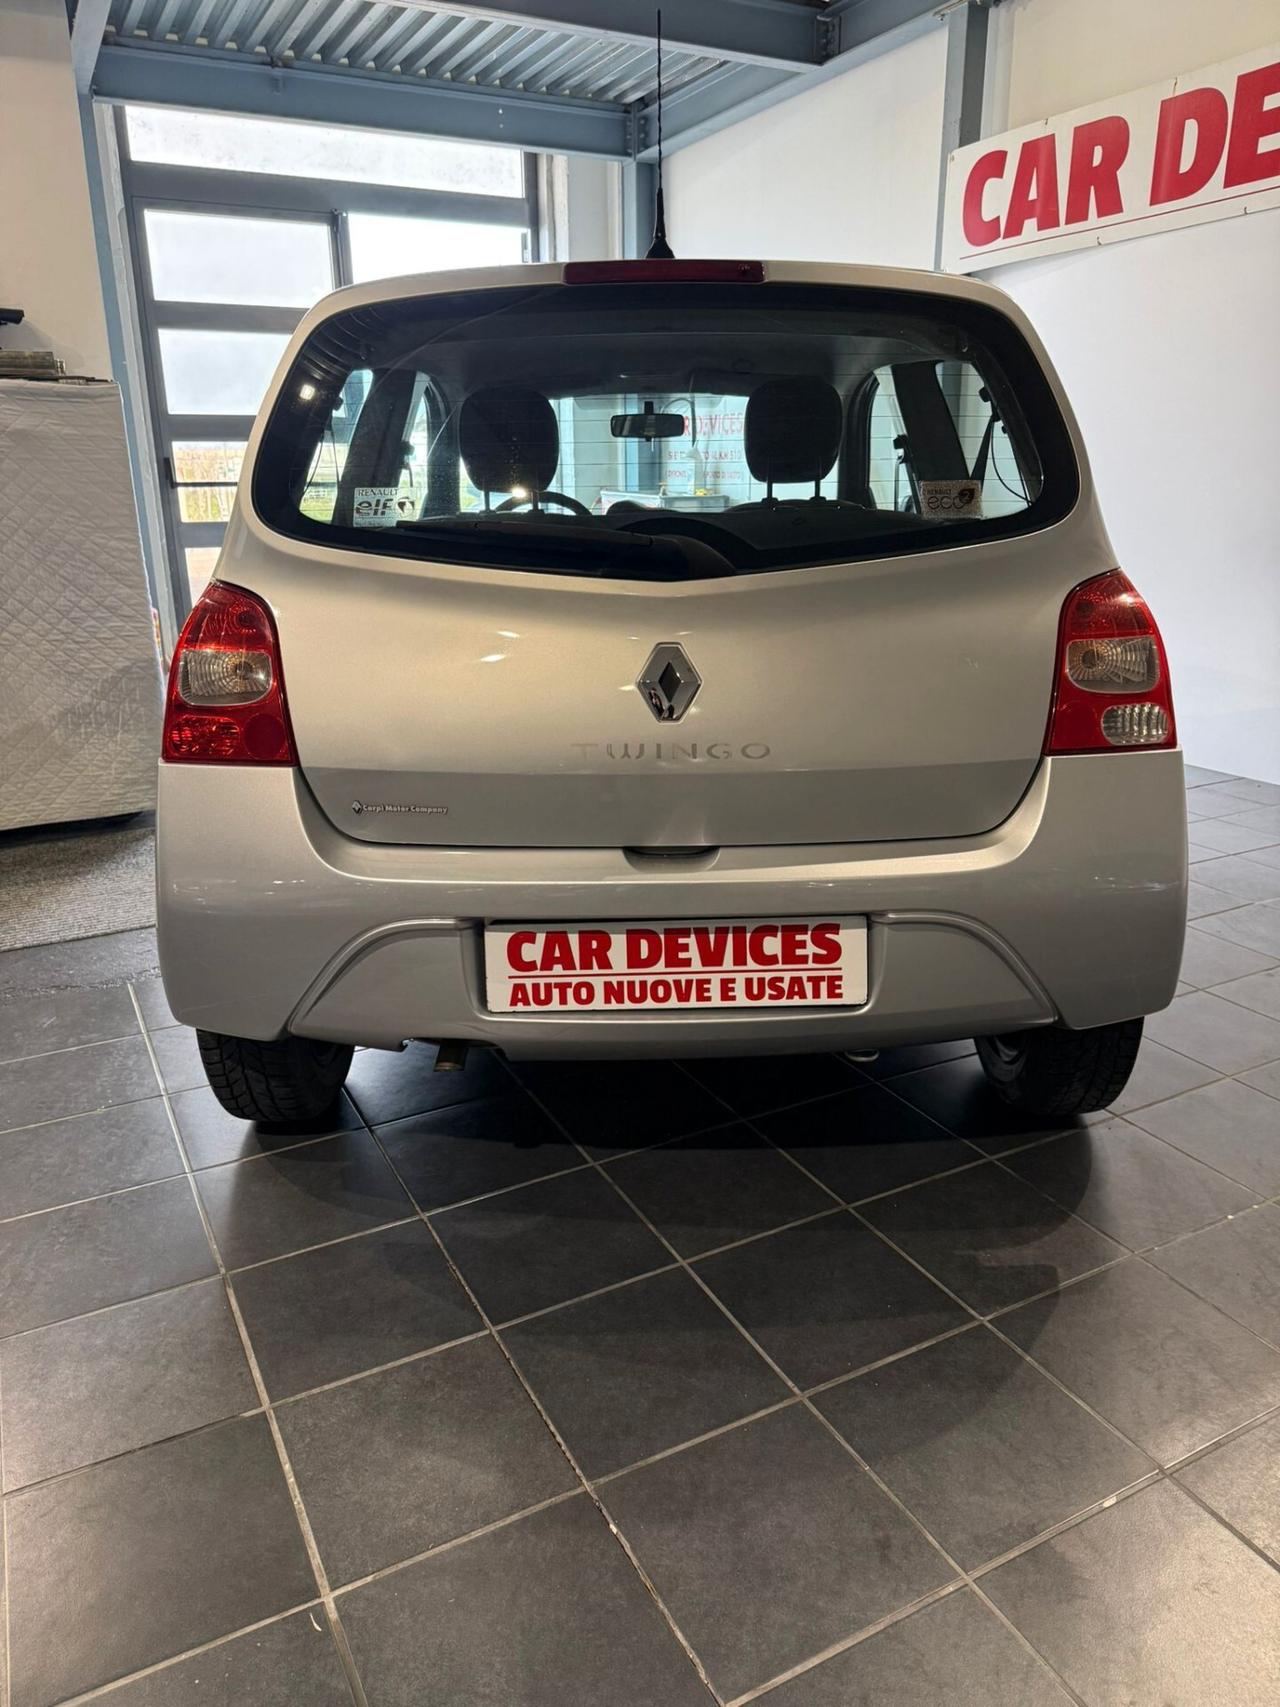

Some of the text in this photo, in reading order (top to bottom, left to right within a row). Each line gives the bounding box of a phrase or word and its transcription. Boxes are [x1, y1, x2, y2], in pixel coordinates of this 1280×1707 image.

[963, 115, 1130, 247] CAR
[358, 488, 399, 497] RENAULT
[570, 743, 771, 760] TWINGO
[385, 805, 409, 813] Motor
[410, 805, 448, 815] Company
[506, 923, 843, 972] CAR DEVICES
[508, 974, 844, 1007] AUTO NUOVE E USATE
